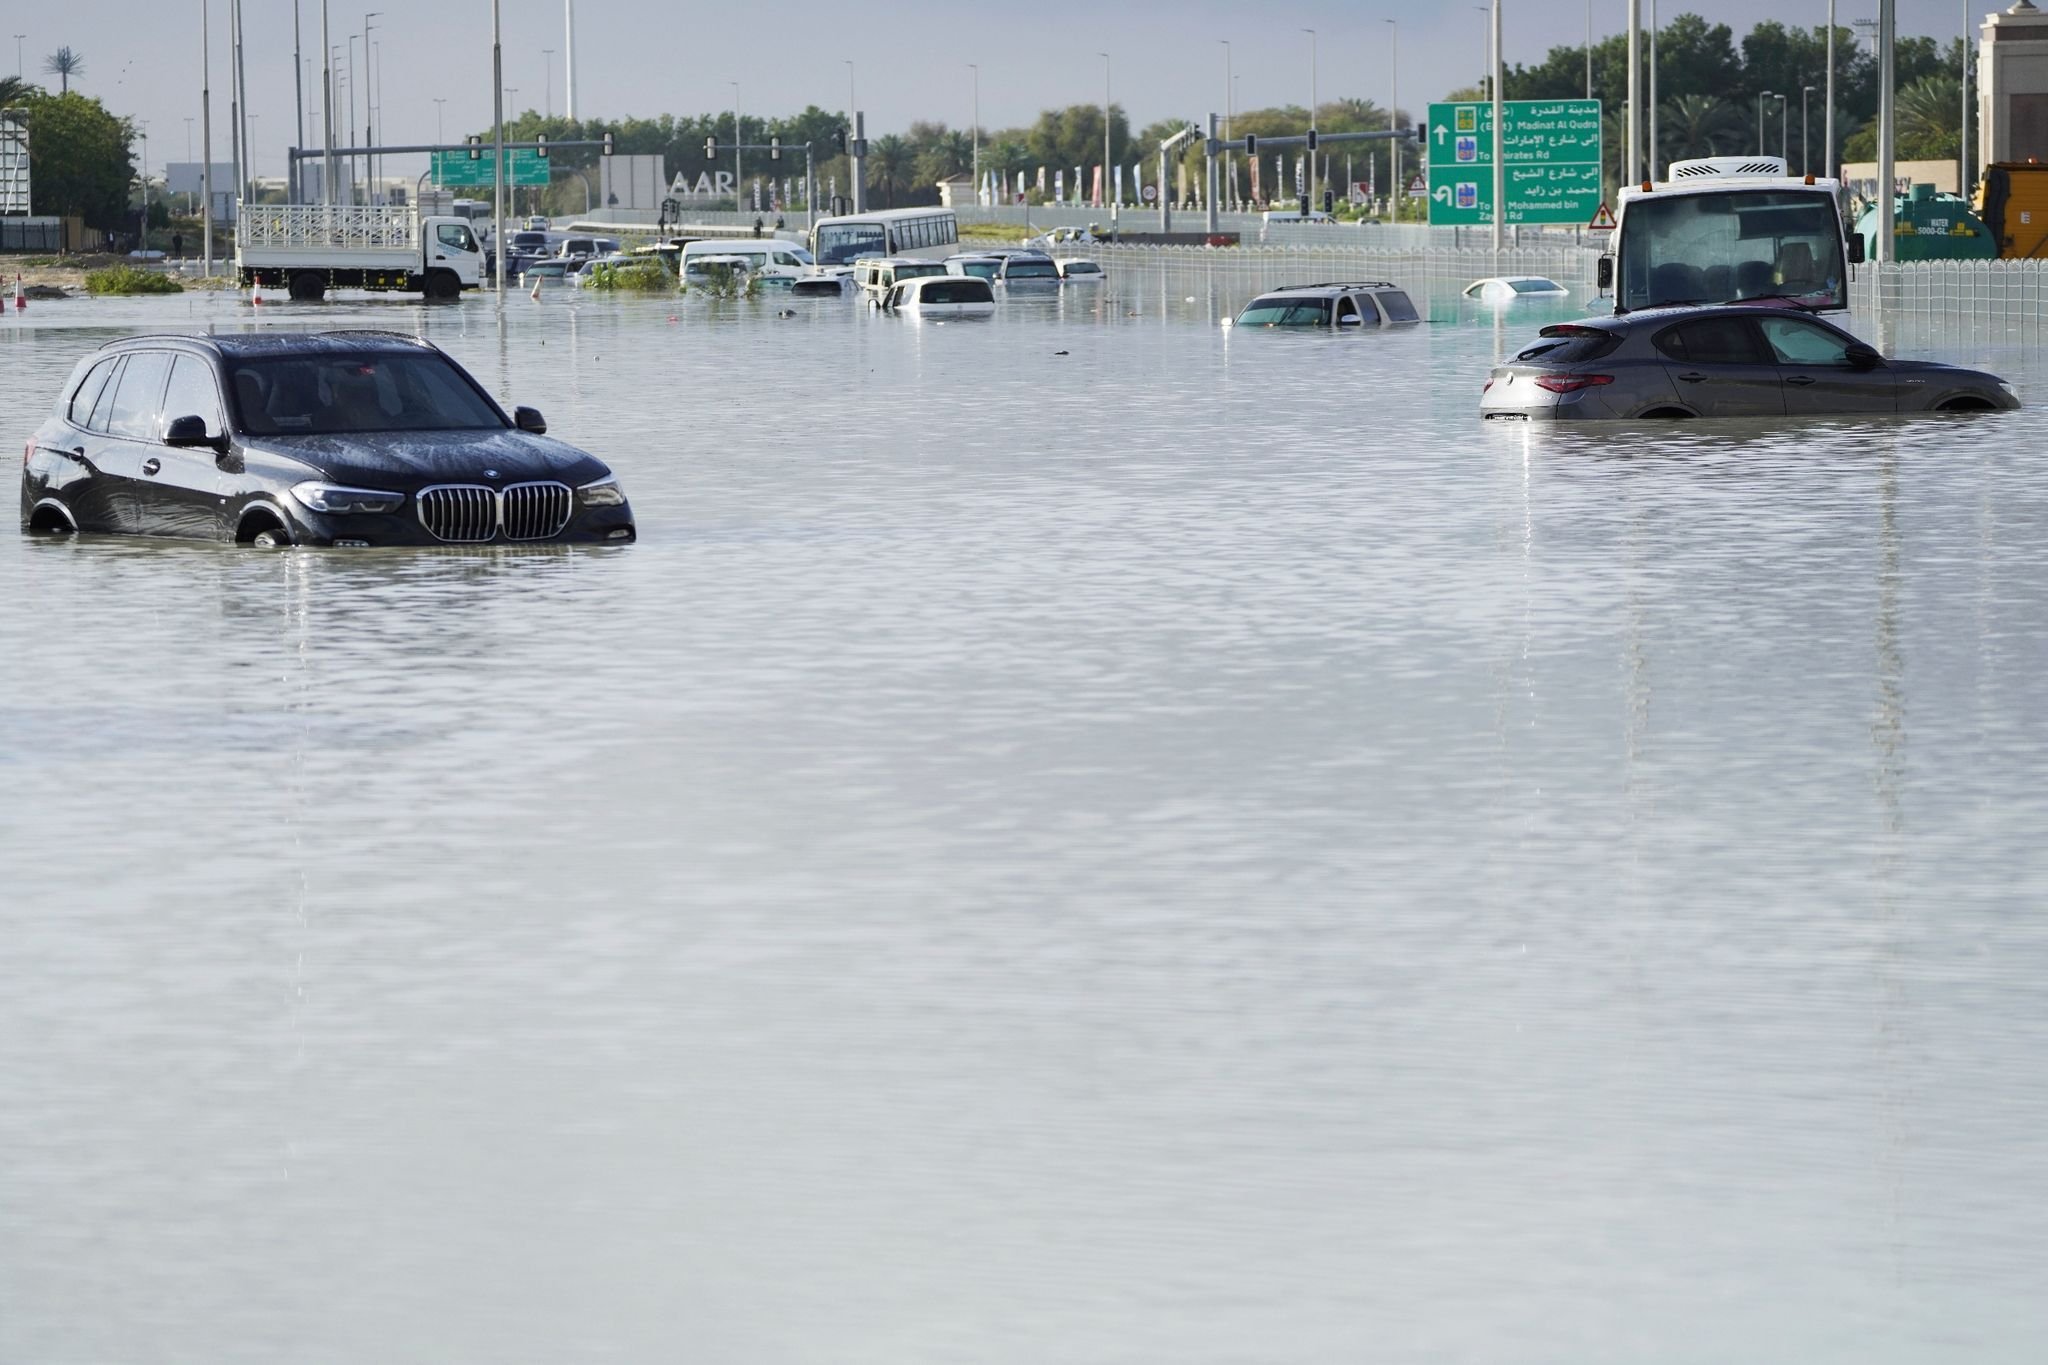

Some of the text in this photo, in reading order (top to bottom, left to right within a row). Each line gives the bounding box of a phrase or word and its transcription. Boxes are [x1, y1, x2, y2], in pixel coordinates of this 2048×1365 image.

[1530, 105, 1564, 117] القدرة
[1568, 104, 1598, 116] مدينة
[1517, 120, 1555, 130] Madinat
[1557, 120, 1568, 129] Al
[1569, 119, 1598, 129] Qudra
[1548, 134, 1577, 147] شارع
[1580, 133, 1598, 148] إلى
[1478, 151, 1490, 160] To
[1535, 150, 1550, 159] Rd
[1512, 166, 1598, 181] إلى شارع الشيخ
[1524, 184, 1598, 197] محمد بن زايد
[1478, 201, 1491, 210] To
[1508, 200, 1562, 210] Mohammed
[1564, 200, 1579, 209] bin
[1509, 211, 1524, 220] Rd
[1931, 218, 1949, 228] WATER
